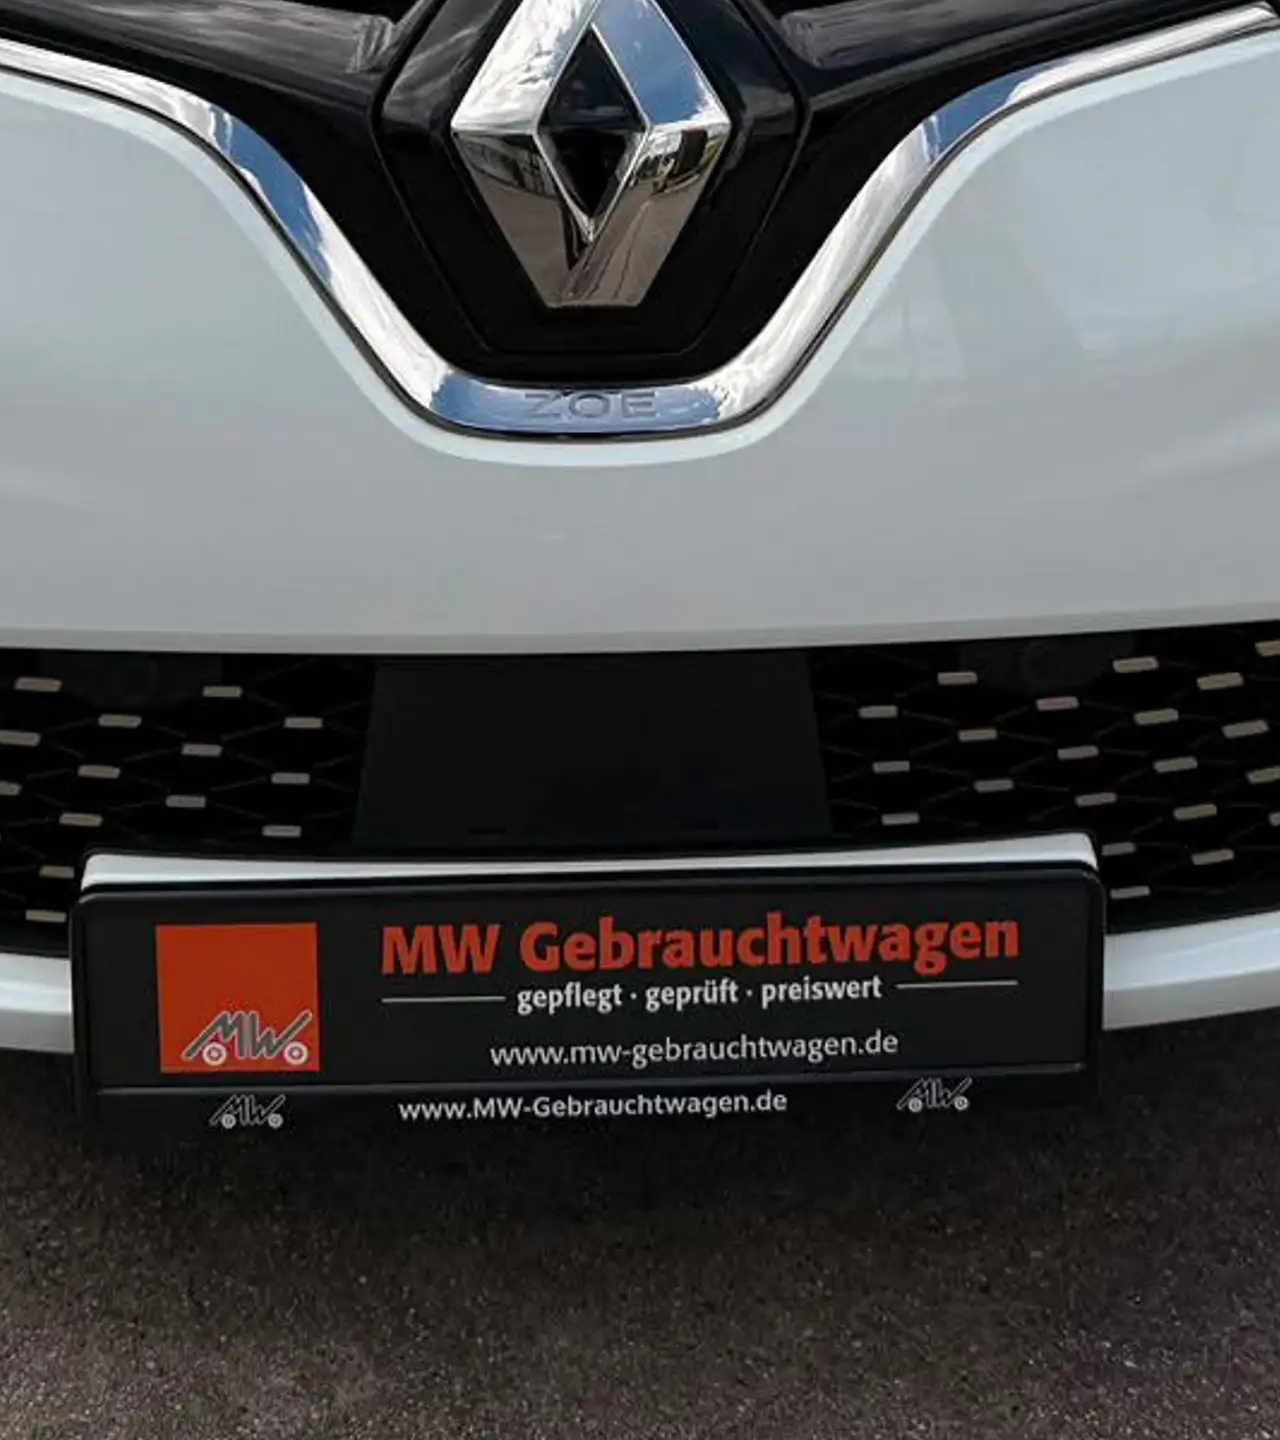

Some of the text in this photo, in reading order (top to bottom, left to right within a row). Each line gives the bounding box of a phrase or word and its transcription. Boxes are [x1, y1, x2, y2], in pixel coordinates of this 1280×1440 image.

[524, 390, 658, 420] ZOE
[381, 911, 1019, 976] MW Gebrauchtwagen
[517, 975, 883, 1015] gepflegt geprüft preiswert
[181, 1008, 313, 1063] MW
[489, 1028, 899, 1070] www.mw-gebrauchtwagen.de
[398, 1089, 788, 1121] www.MW-Gebrauchtwagen.de
